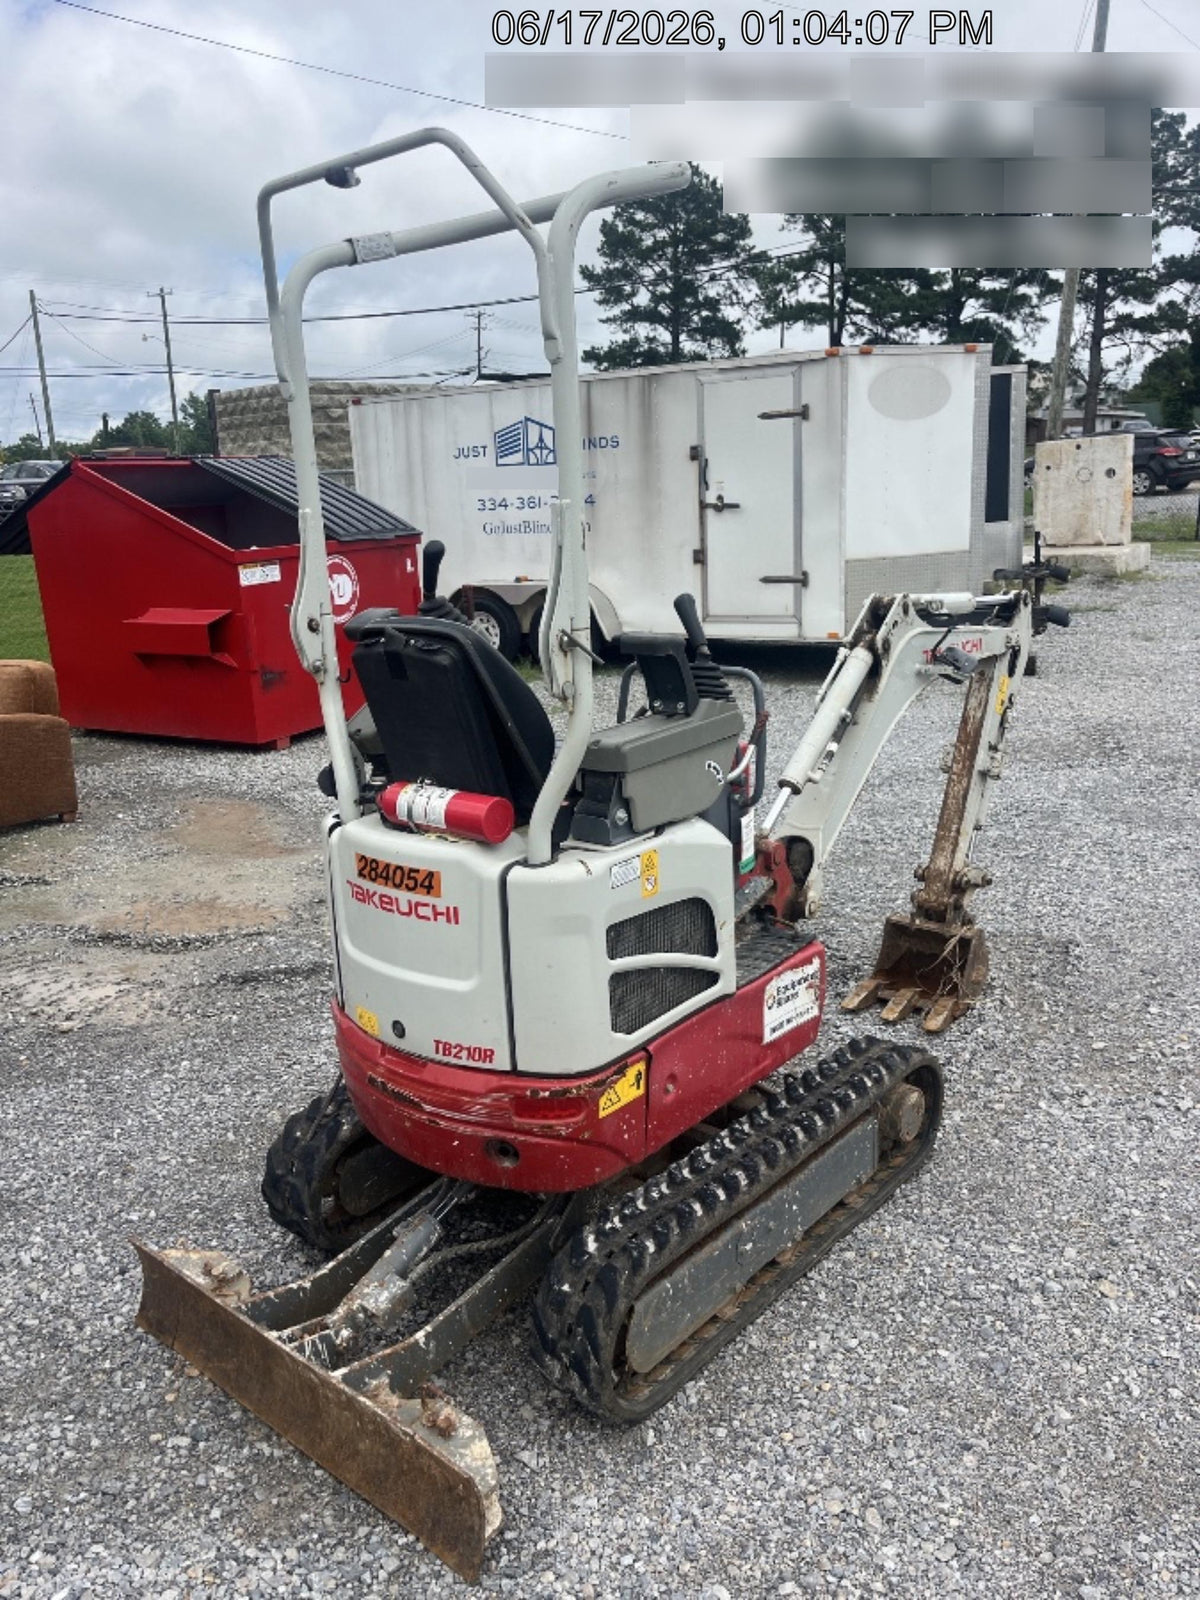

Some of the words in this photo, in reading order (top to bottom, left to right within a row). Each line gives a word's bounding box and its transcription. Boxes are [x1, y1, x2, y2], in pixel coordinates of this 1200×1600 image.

[453, 446, 488, 459] JUST
[582, 435, 620, 451] INDS
[477, 493, 597, 511] 334-361-4
[357, 854, 435, 895] 284054
[346, 879, 460, 926] TAKEUCHI
[433, 1039, 495, 1064] TB210R
